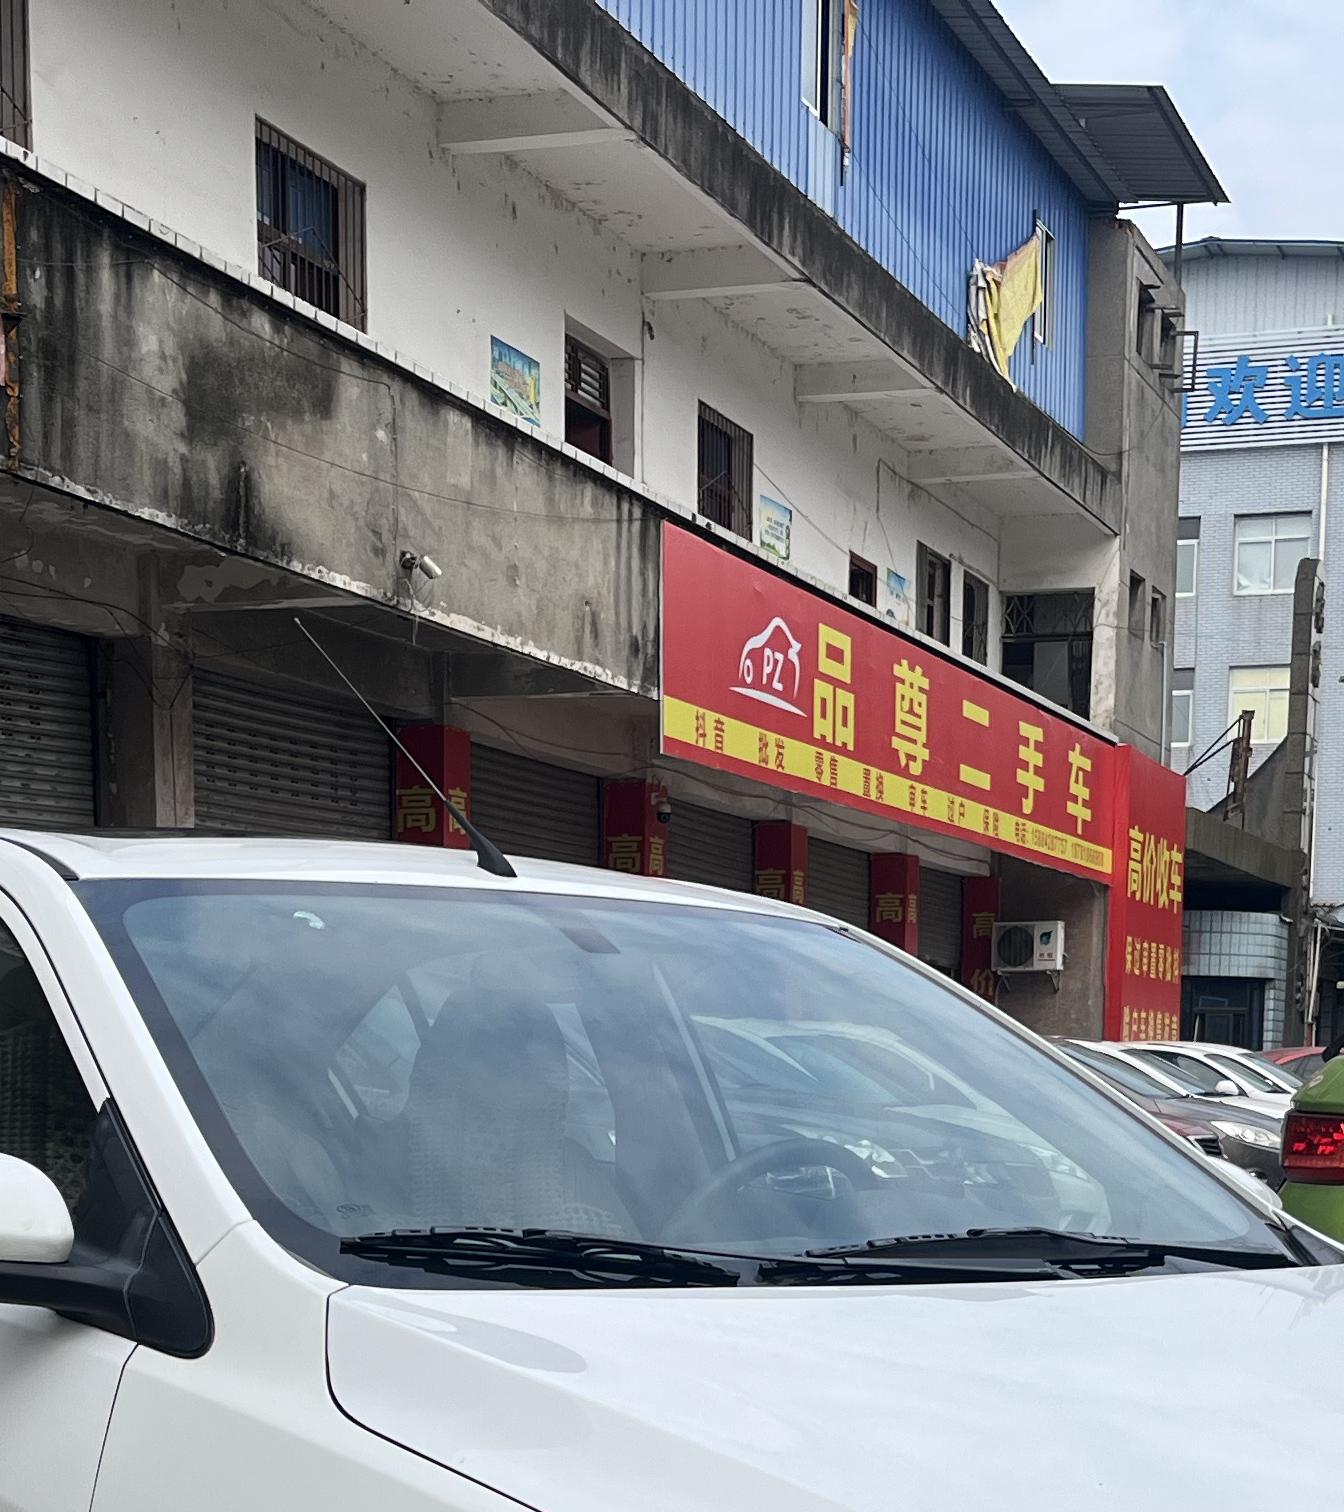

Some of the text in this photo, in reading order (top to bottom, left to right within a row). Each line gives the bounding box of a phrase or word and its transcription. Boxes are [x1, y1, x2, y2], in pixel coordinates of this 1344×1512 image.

[762, 646, 784, 691] PZ
[813, 623, 1092, 835] 品尊二手车
[695, 710, 725, 753] 抖音
[758, 731, 786, 771] 批发
[814, 751, 839, 787] 零售
[947, 796, 966, 824] 过户
[397, 785, 437, 833] 高
[448, 787, 468, 835] 高
[607, 833, 643, 873] 高
[648, 836, 665, 876] 高
[1127, 825, 1183, 914] 高价收车
[755, 868, 787, 901] 高
[792, 869, 805, 904] 高
[875, 892, 905, 923] 高
[907, 894, 918, 924] 高
